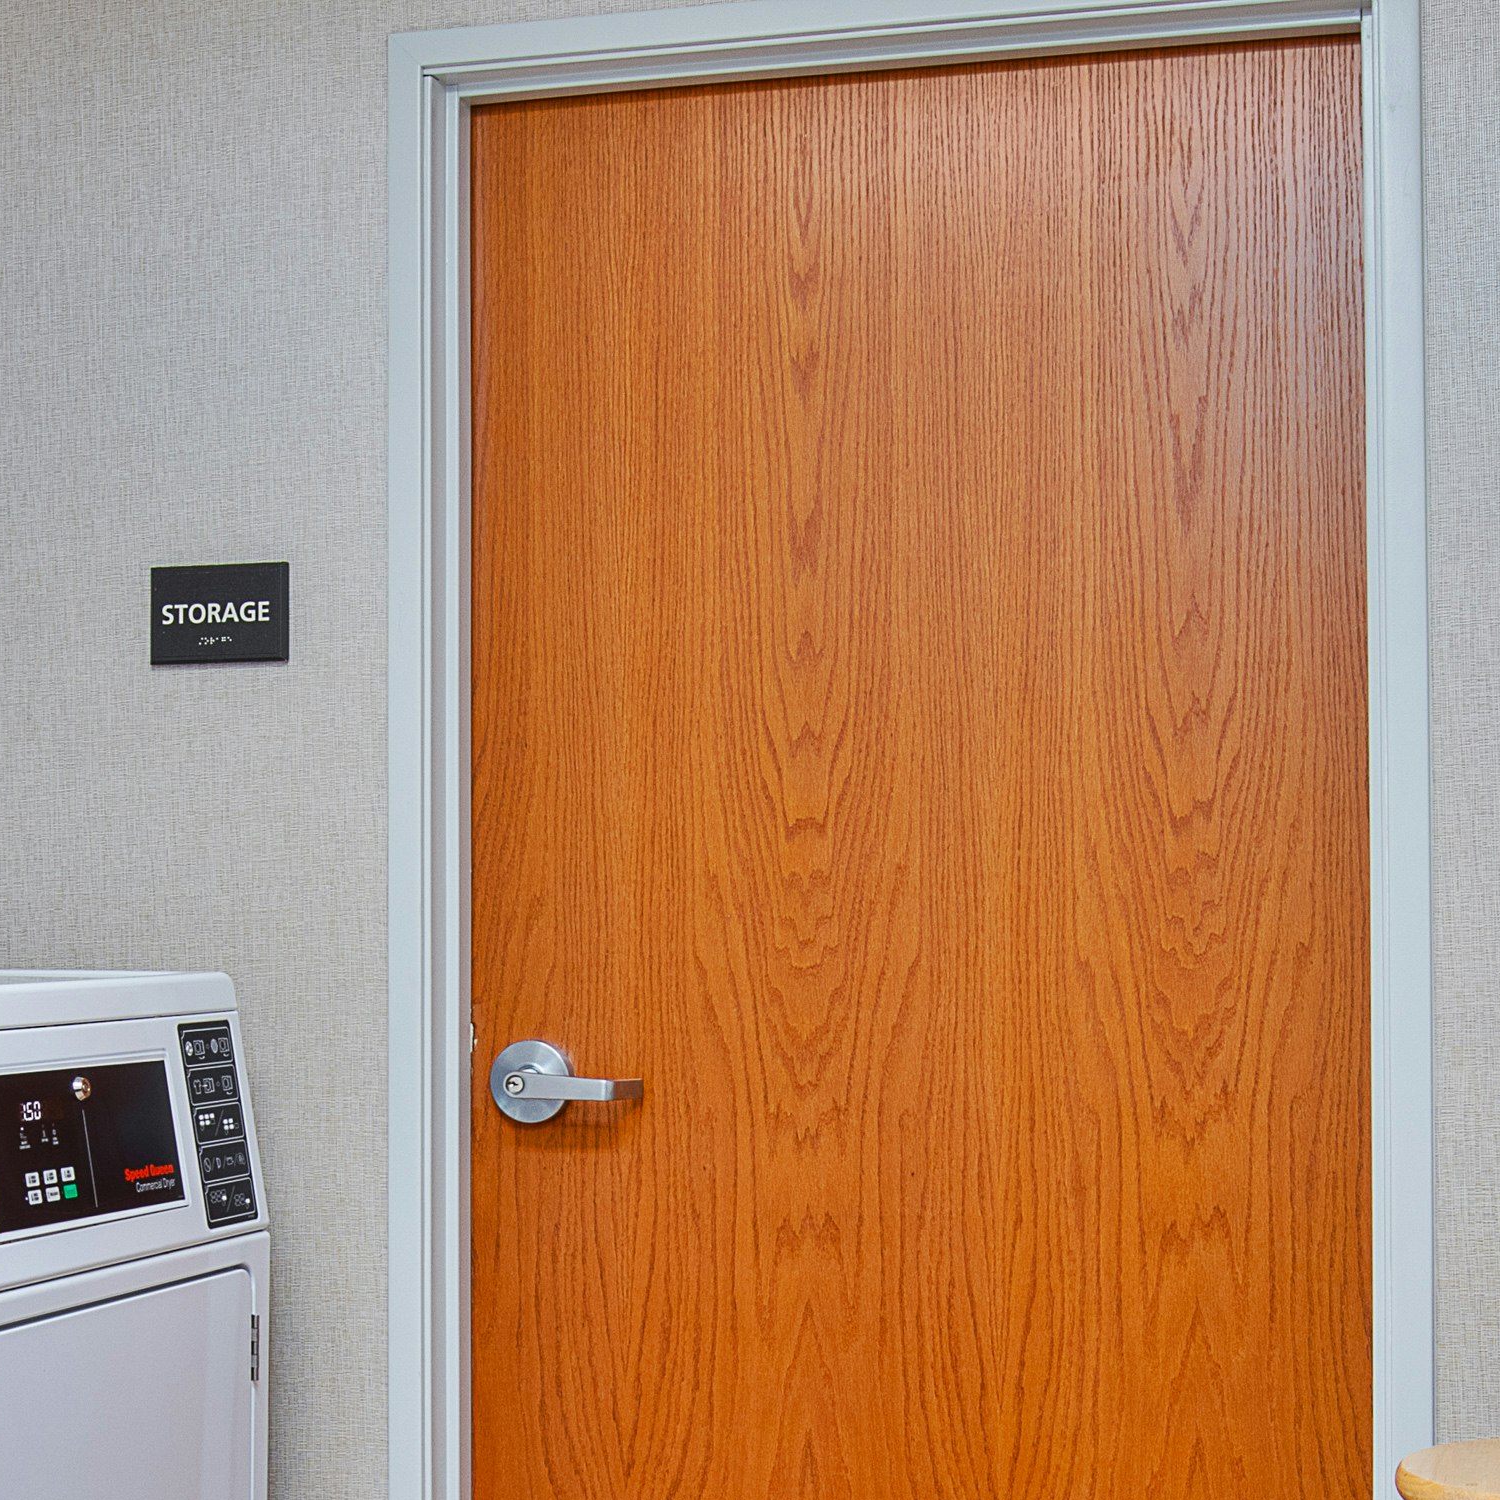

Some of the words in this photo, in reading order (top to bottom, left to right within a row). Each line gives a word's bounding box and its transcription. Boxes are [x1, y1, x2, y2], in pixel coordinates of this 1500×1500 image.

[162, 601, 269, 624] STORAGE
[124, 1164, 150, 1182] Speed
[149, 1163, 175, 1177] Queen
[135, 1182, 162, 1193] Commercial
[162, 1177, 176, 1189] Dryer
